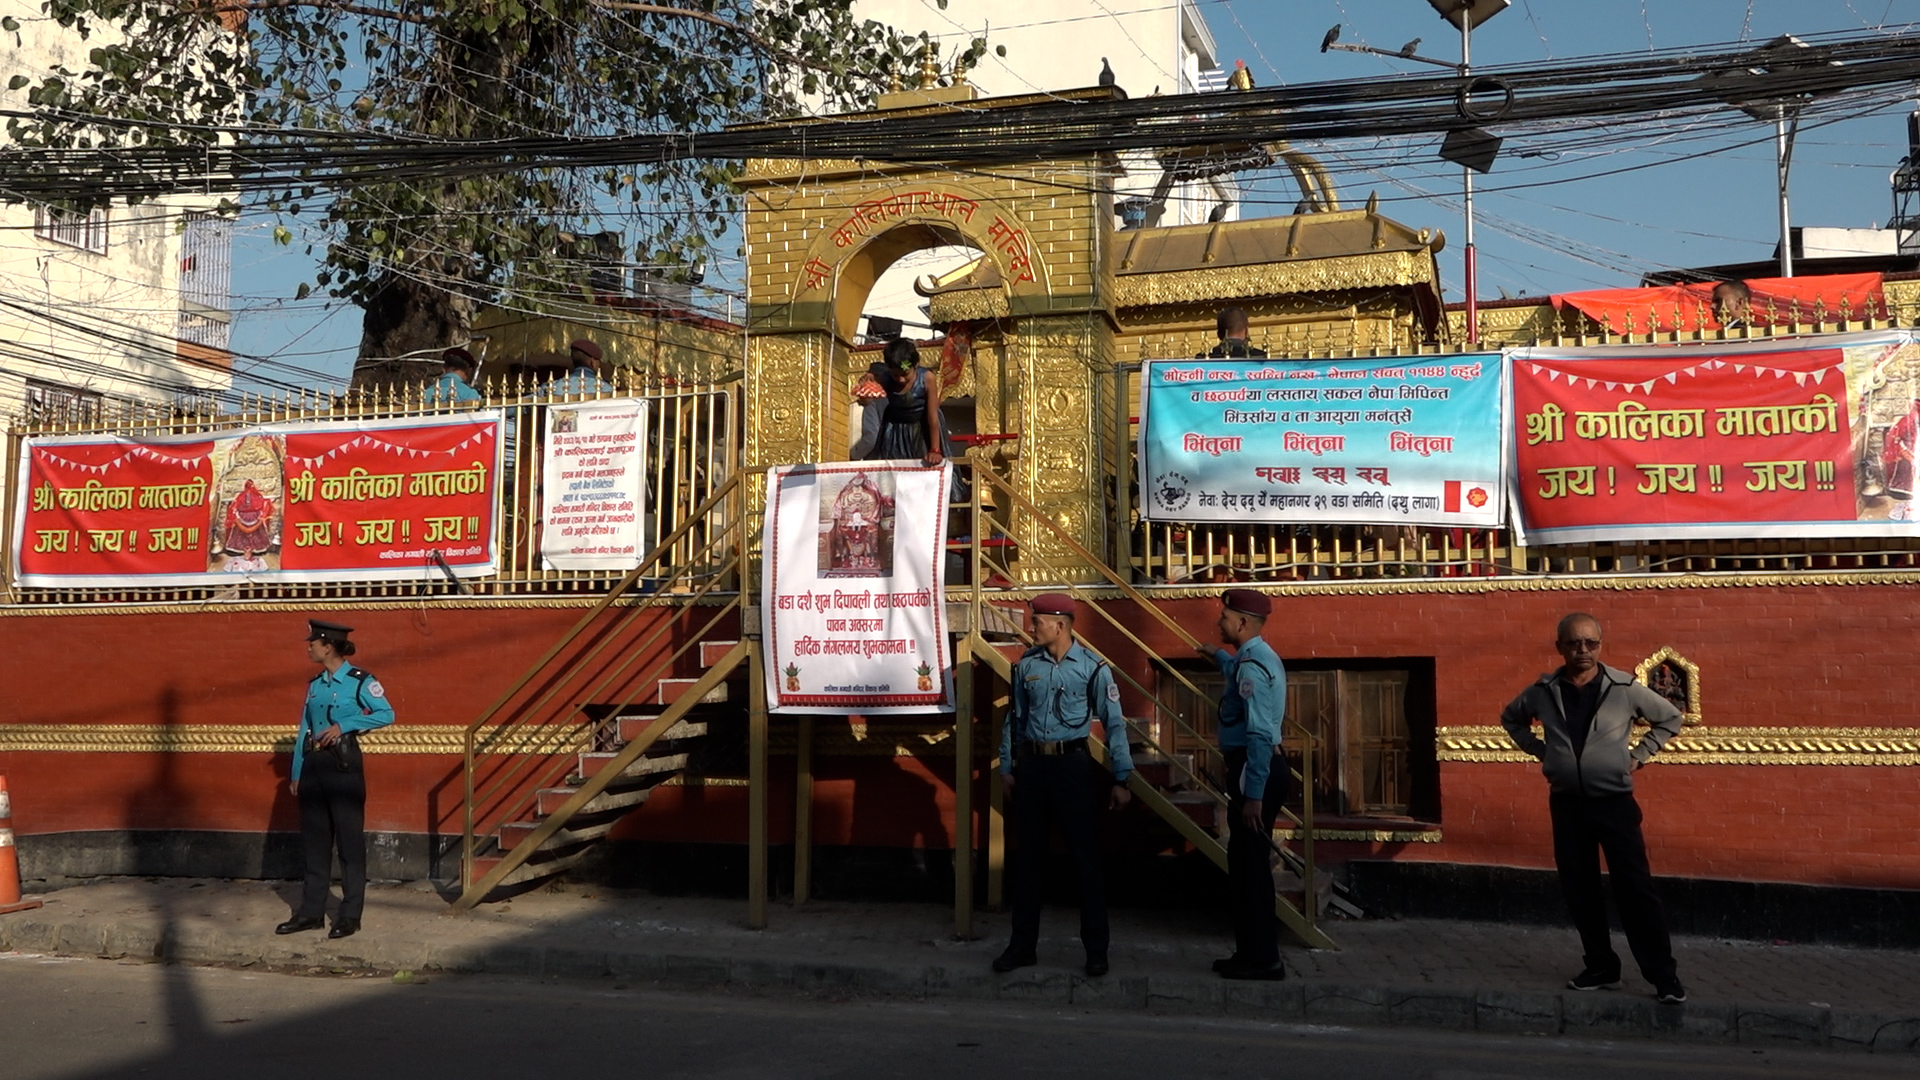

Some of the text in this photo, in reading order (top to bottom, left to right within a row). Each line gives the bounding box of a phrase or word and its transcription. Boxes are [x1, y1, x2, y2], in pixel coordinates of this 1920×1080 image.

[805, 191, 1036, 290] श्री कालिकास्थान मन्दिर
[1163, 368, 1204, 382] मोहनी
[1327, 367, 1367, 379] नेपाल
[1409, 366, 1445, 378] ११४४
[1191, 391, 1199, 402] व
[1266, 390, 1318, 402] लसताय्
[1323, 388, 1362, 400] सकल
[1281, 412, 1290, 422] व
[1526, 394, 1839, 445] श्री कालिका माताको
[33, 476, 207, 512] श्री कालिका माताको
[289, 461, 487, 504] श्री कालिका माताको
[1270, 494, 1311, 510] महानगर
[1314, 495, 1327, 510] २९
[1331, 495, 1349, 507] वडा
[1352, 491, 1384, 508] समिति
[778, 595, 794, 609] बडा
[815, 595, 831, 613] शुभ
[834, 589, 871, 609] दिपावली
[874, 594, 890, 609] तथा
[827, 619, 883, 632] पावन अवसरमा
[794, 635, 821, 656] हार्दिक
[823, 637, 860, 655] मंगलमय
[863, 639, 907, 659] शुभकामना
